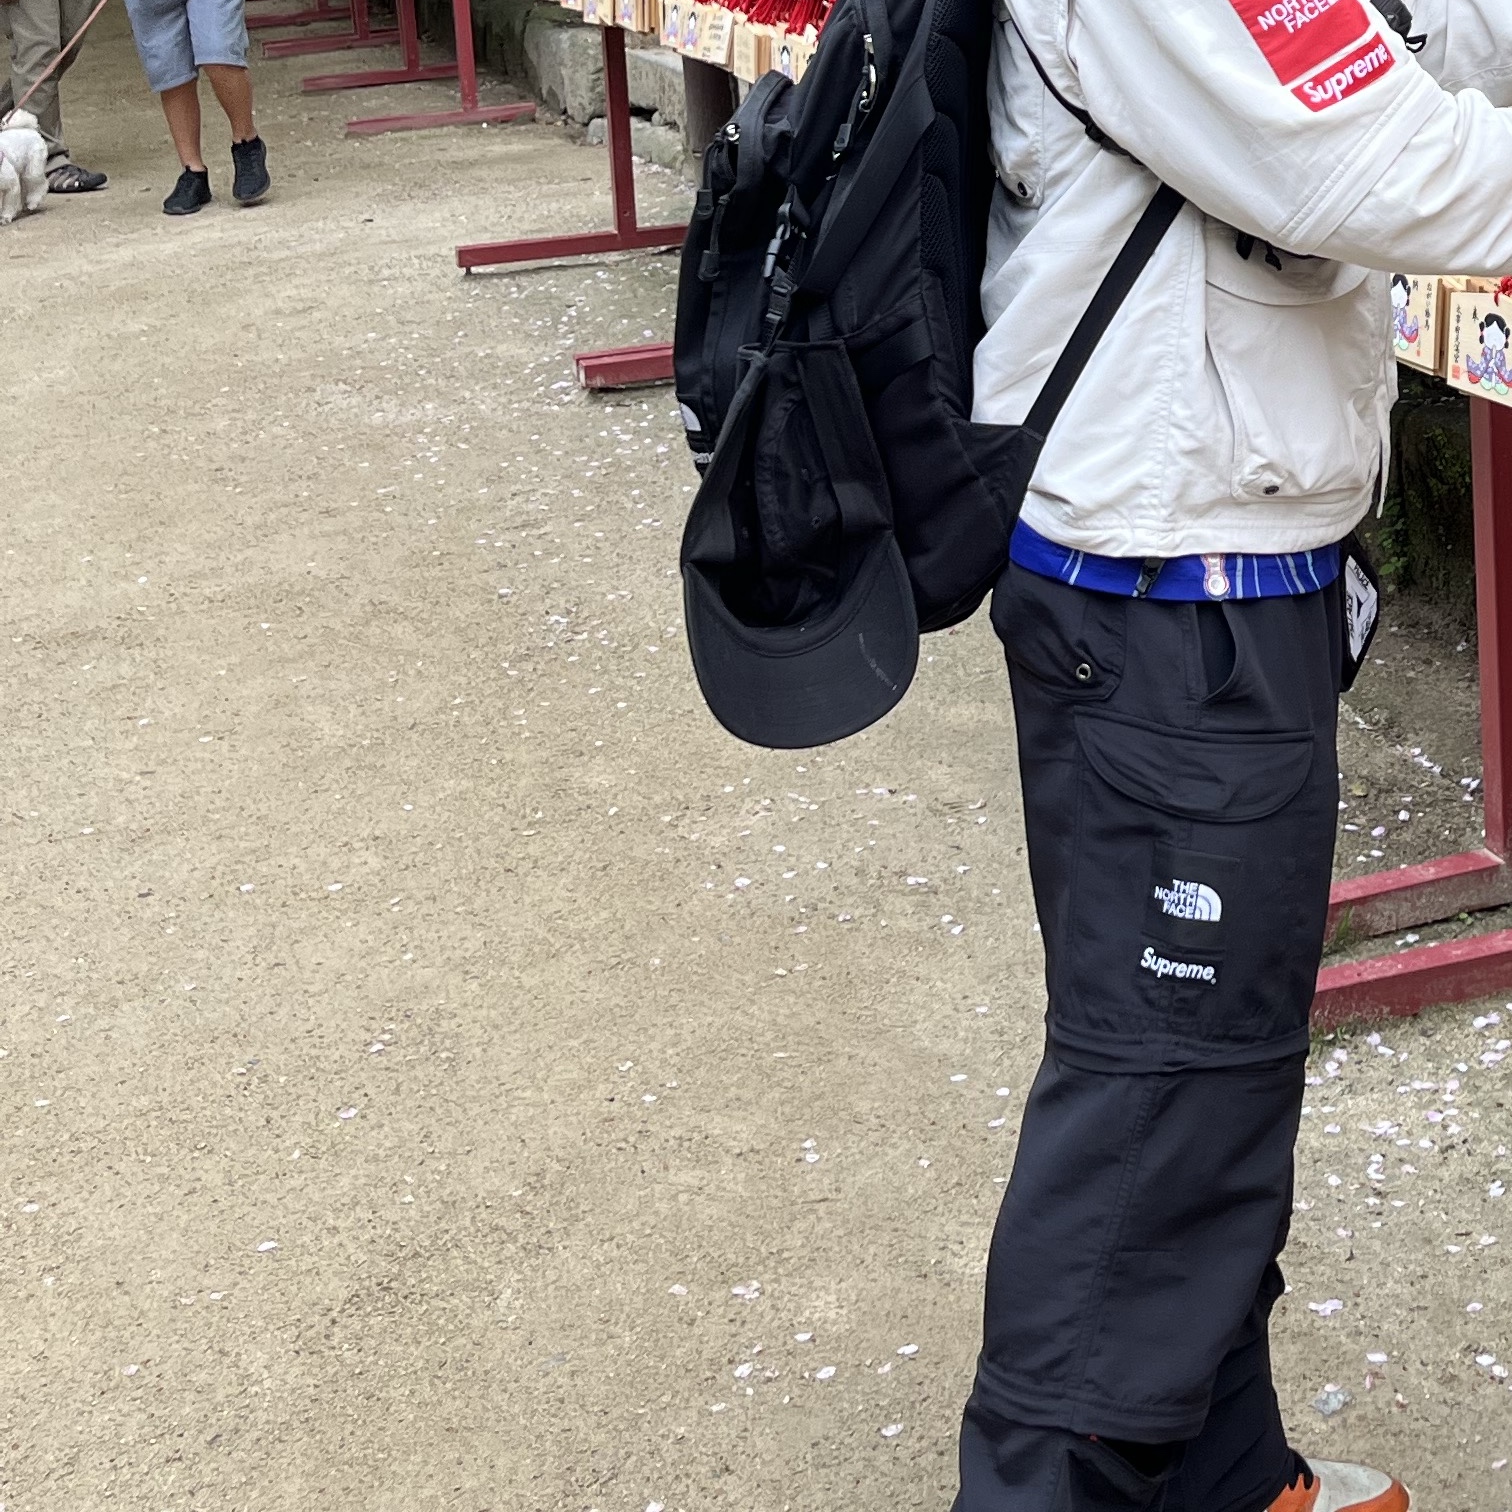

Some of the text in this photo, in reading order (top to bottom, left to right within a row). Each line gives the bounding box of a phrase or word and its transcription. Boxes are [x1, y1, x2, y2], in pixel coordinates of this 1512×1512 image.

[1302, 43, 1390, 103] Supreme
[1154, 886, 1197, 907] NORTH
[1172, 879, 1198, 894] THE
[1162, 900, 1194, 919] FACE
[1140, 946, 1215, 980] Supreme
